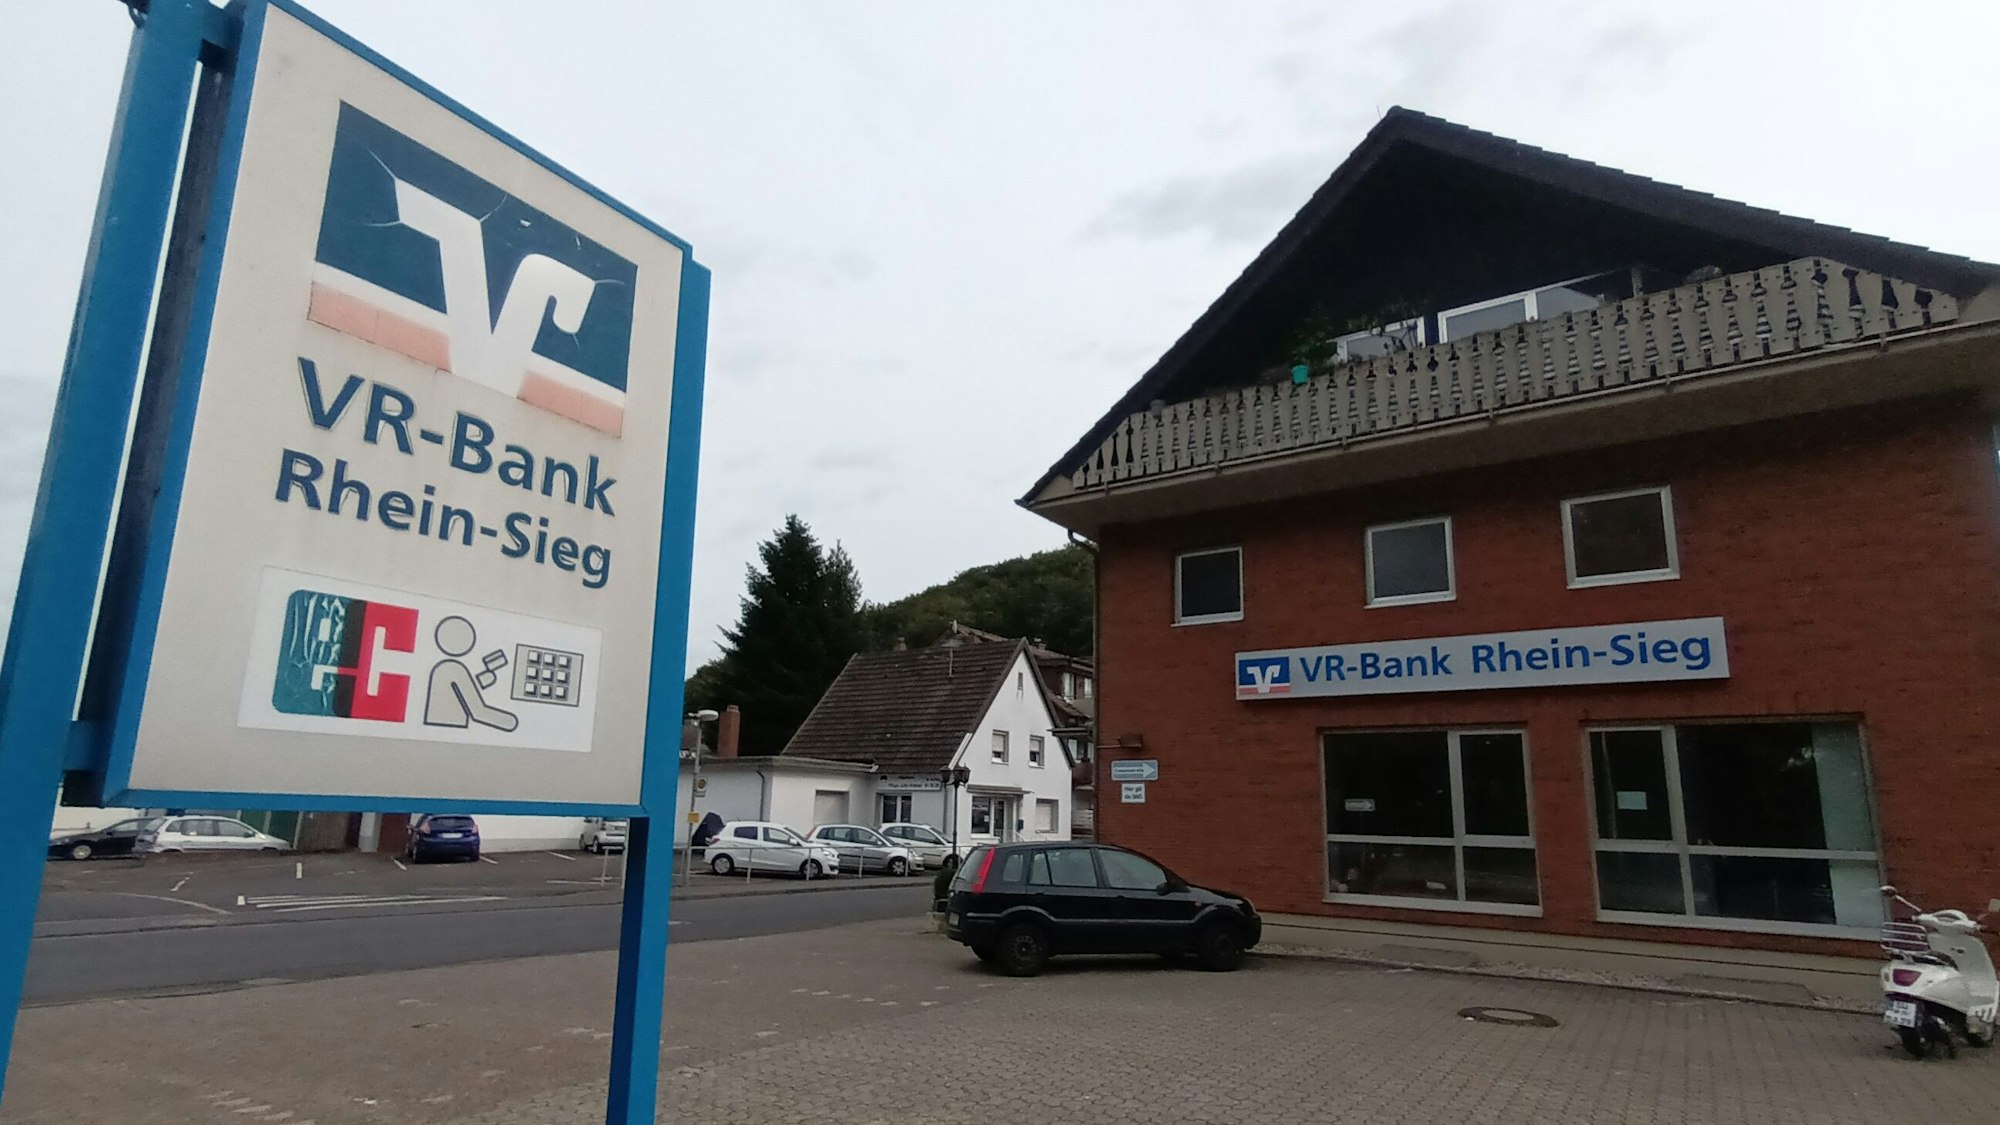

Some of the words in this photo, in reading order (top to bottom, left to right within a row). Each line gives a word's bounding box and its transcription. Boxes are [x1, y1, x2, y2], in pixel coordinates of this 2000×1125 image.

[298, 356, 617, 517] VR-Bank
[275, 448, 611, 589] Rhein-Sieg
[1300, 646, 1453, 683] VR-Bank
[1471, 632, 1712, 674] Rhein-Sieg
